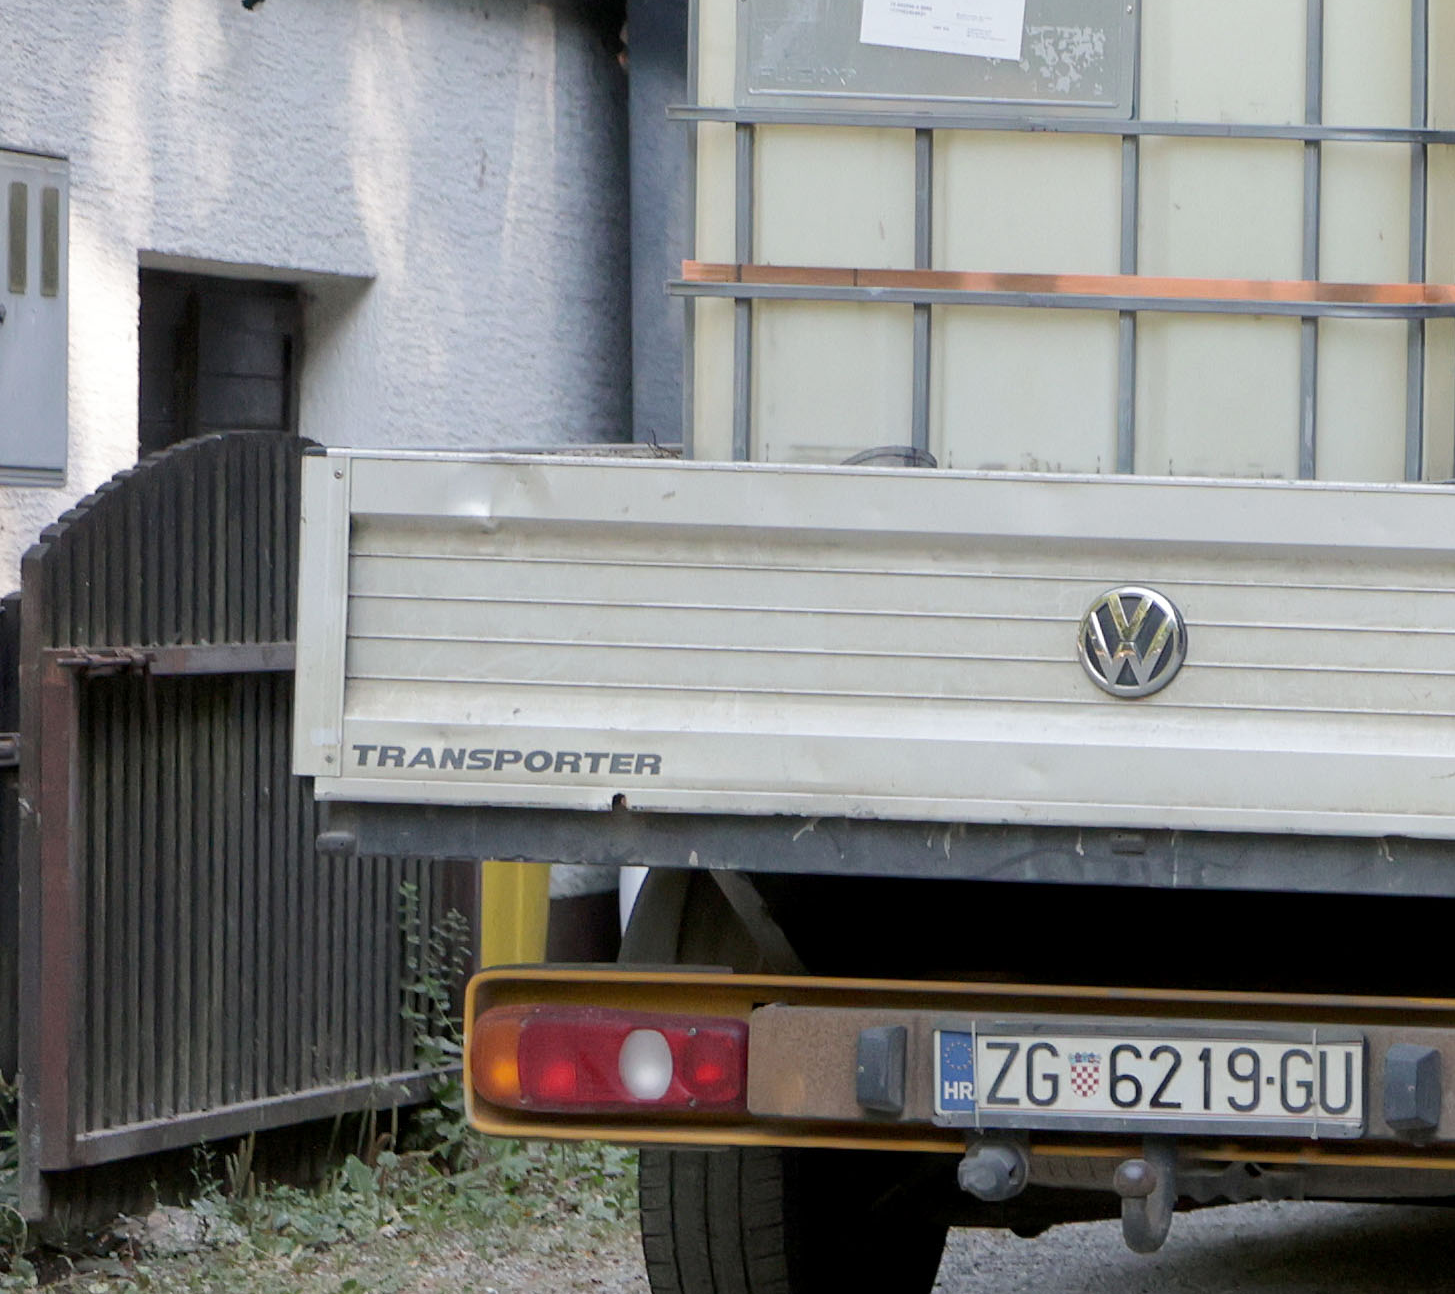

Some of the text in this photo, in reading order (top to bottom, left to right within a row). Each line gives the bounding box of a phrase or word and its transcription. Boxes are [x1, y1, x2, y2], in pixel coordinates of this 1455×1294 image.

[352, 744, 663, 775] TRANSPORTER
[985, 1042, 1060, 1107] ZG
[943, 1081, 976, 1101] HR
